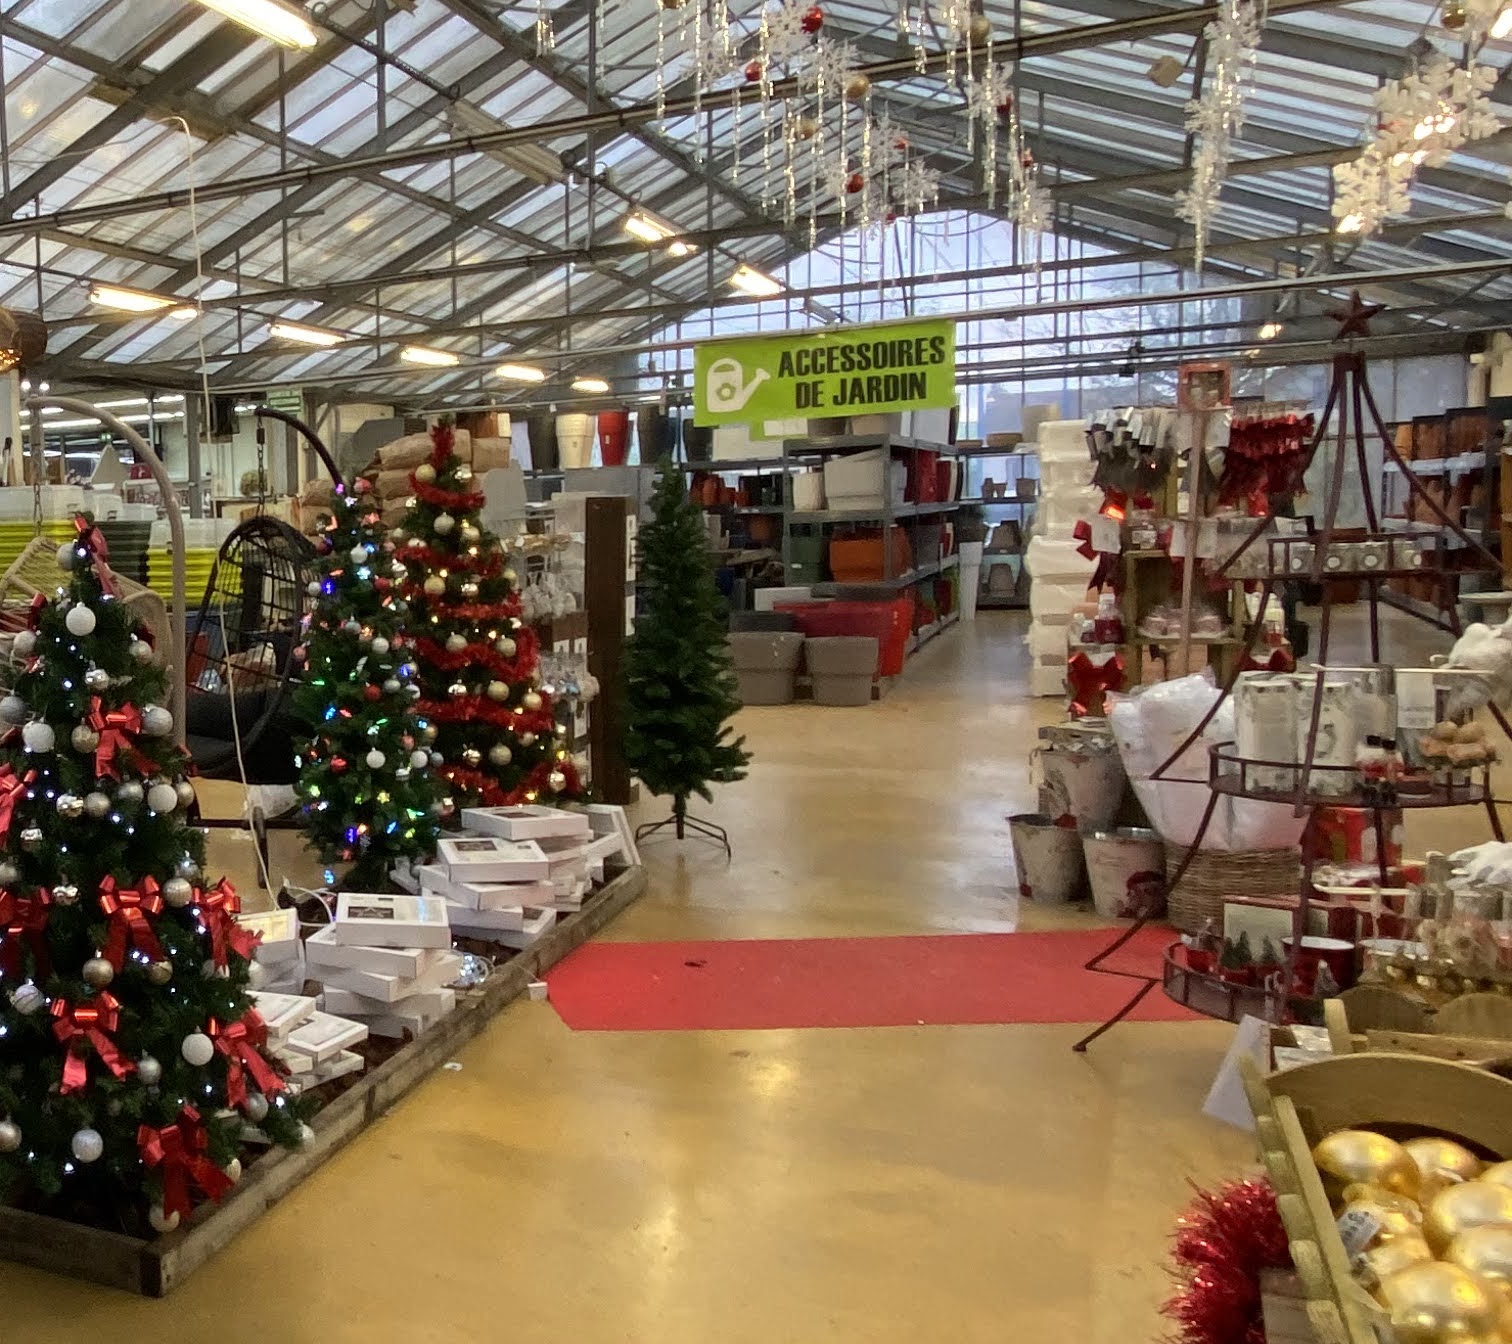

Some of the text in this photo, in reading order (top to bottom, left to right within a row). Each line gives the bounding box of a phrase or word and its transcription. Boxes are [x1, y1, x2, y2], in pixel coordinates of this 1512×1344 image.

[778, 336, 945, 378] ACCESSOIRES
[795, 372, 926, 409] DE JARDIN
